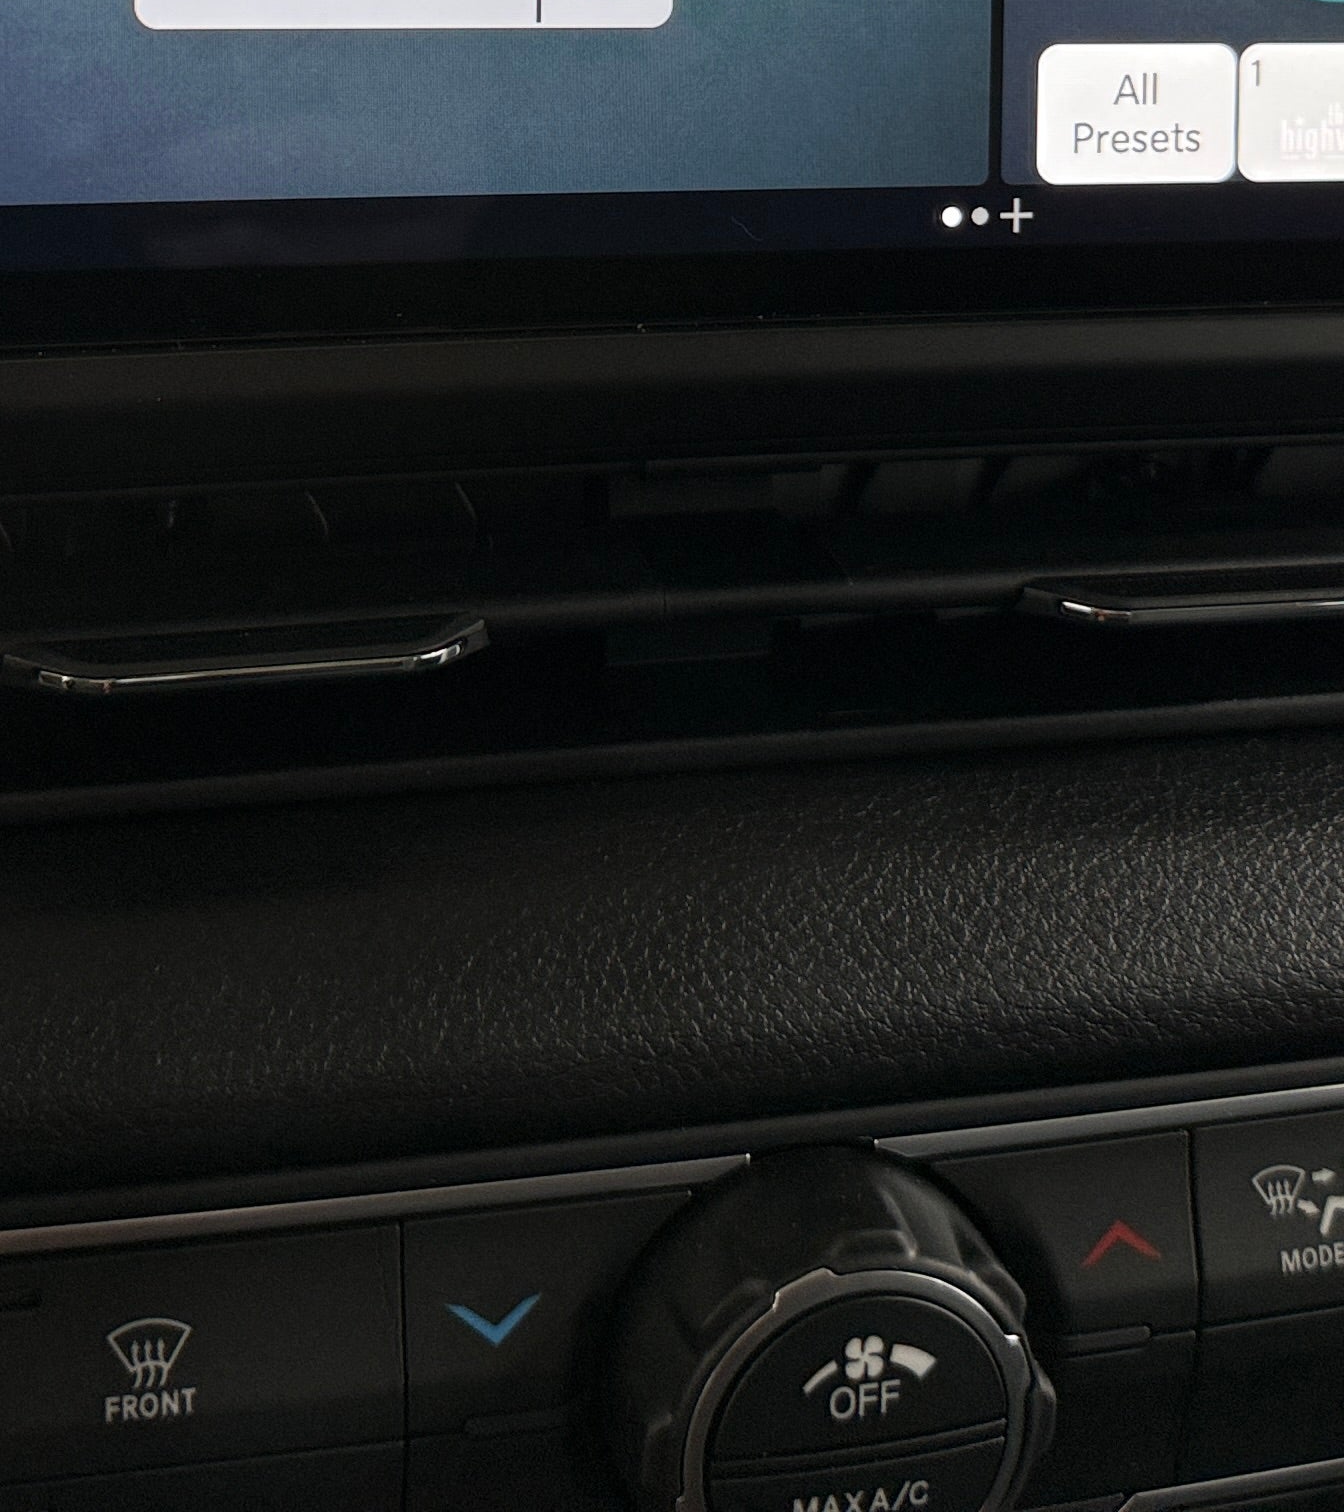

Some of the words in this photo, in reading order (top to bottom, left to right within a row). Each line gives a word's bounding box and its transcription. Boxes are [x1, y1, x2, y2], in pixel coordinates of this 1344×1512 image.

[1112, 72, 1158, 106] All
[1250, 59, 1262, 87] 1
[1073, 122, 1201, 154] Presets
[104, 1387, 197, 1424] FRONT
[829, 1378, 901, 1421] OFF
[792, 1490, 865, 1512] MAX
[868, 1479, 930, 1512] A/C
